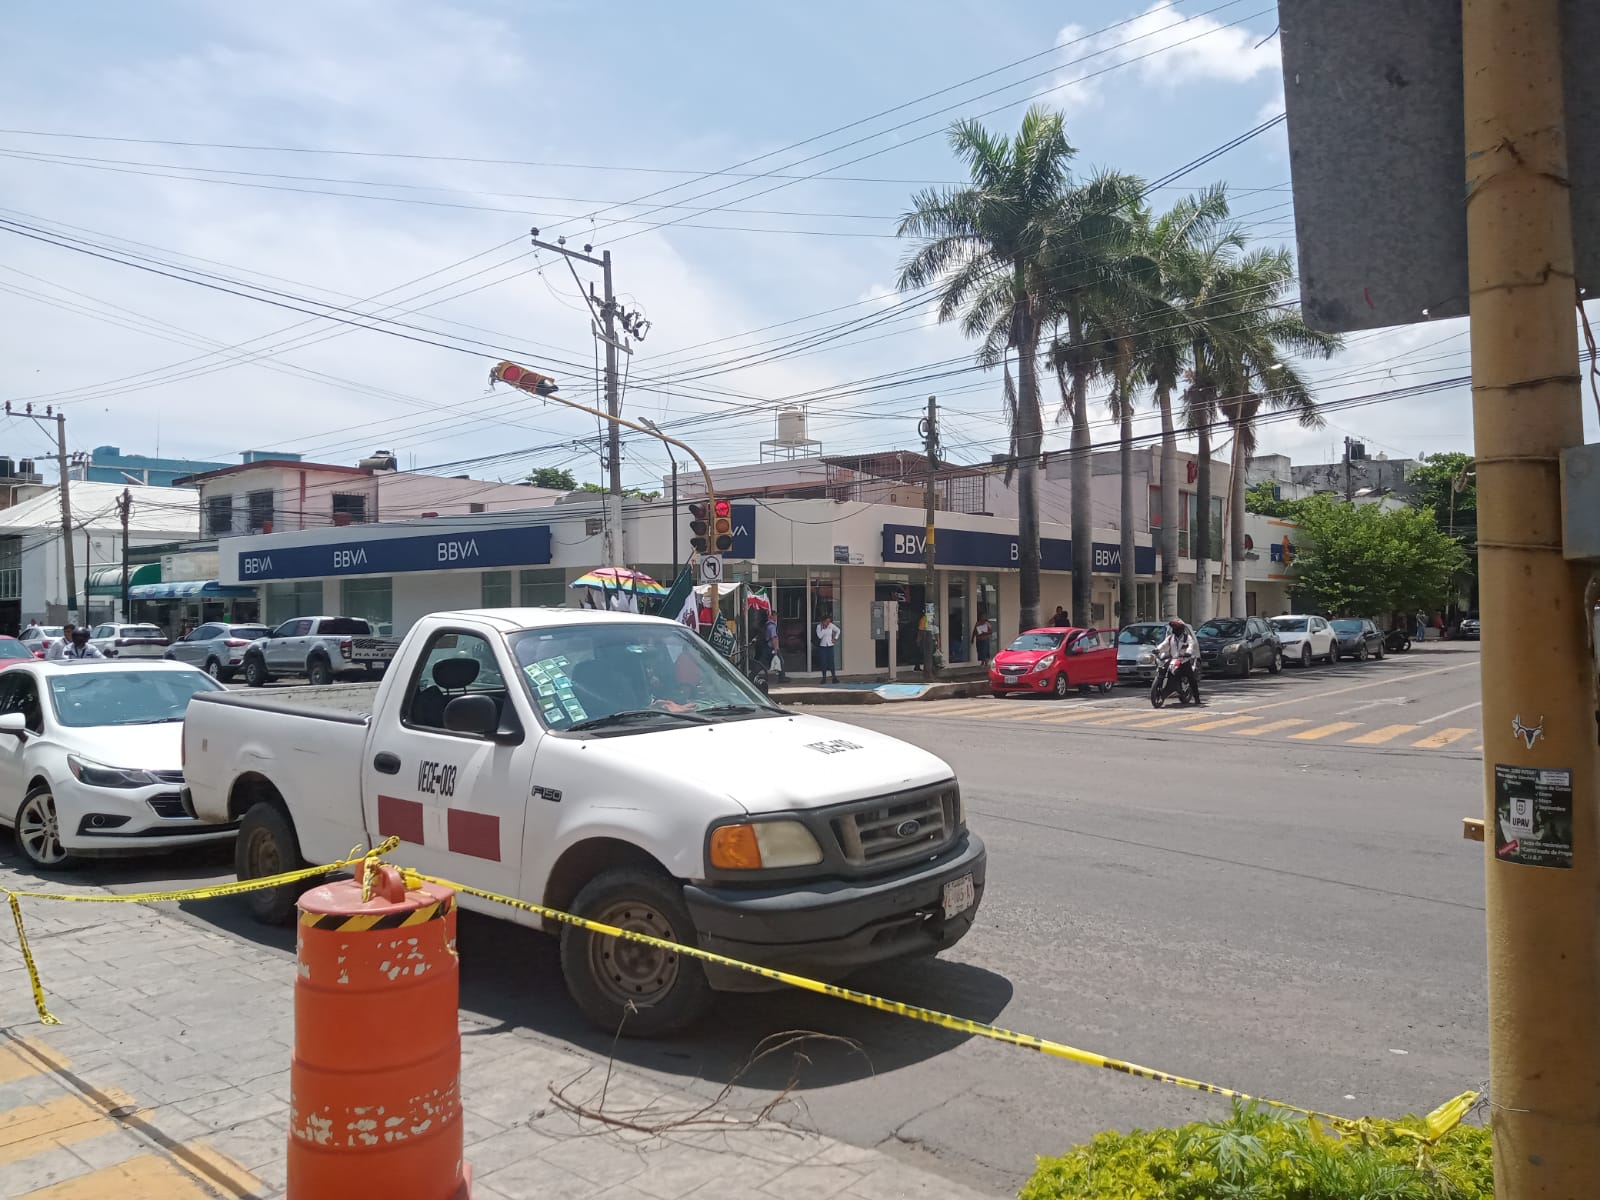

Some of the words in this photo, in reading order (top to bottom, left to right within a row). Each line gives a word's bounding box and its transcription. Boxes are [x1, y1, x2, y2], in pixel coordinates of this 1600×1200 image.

[731, 524, 749, 538] VA
[436, 537, 480, 562] BBVA
[894, 533, 936, 555] BBV
[244, 555, 273, 574] BBVA
[333, 547, 368, 568] BBVA
[1095, 549, 1121, 567] BBVA
[417, 760, 457, 797] VECE-003
[1512, 817, 1530, 828] UPAV
